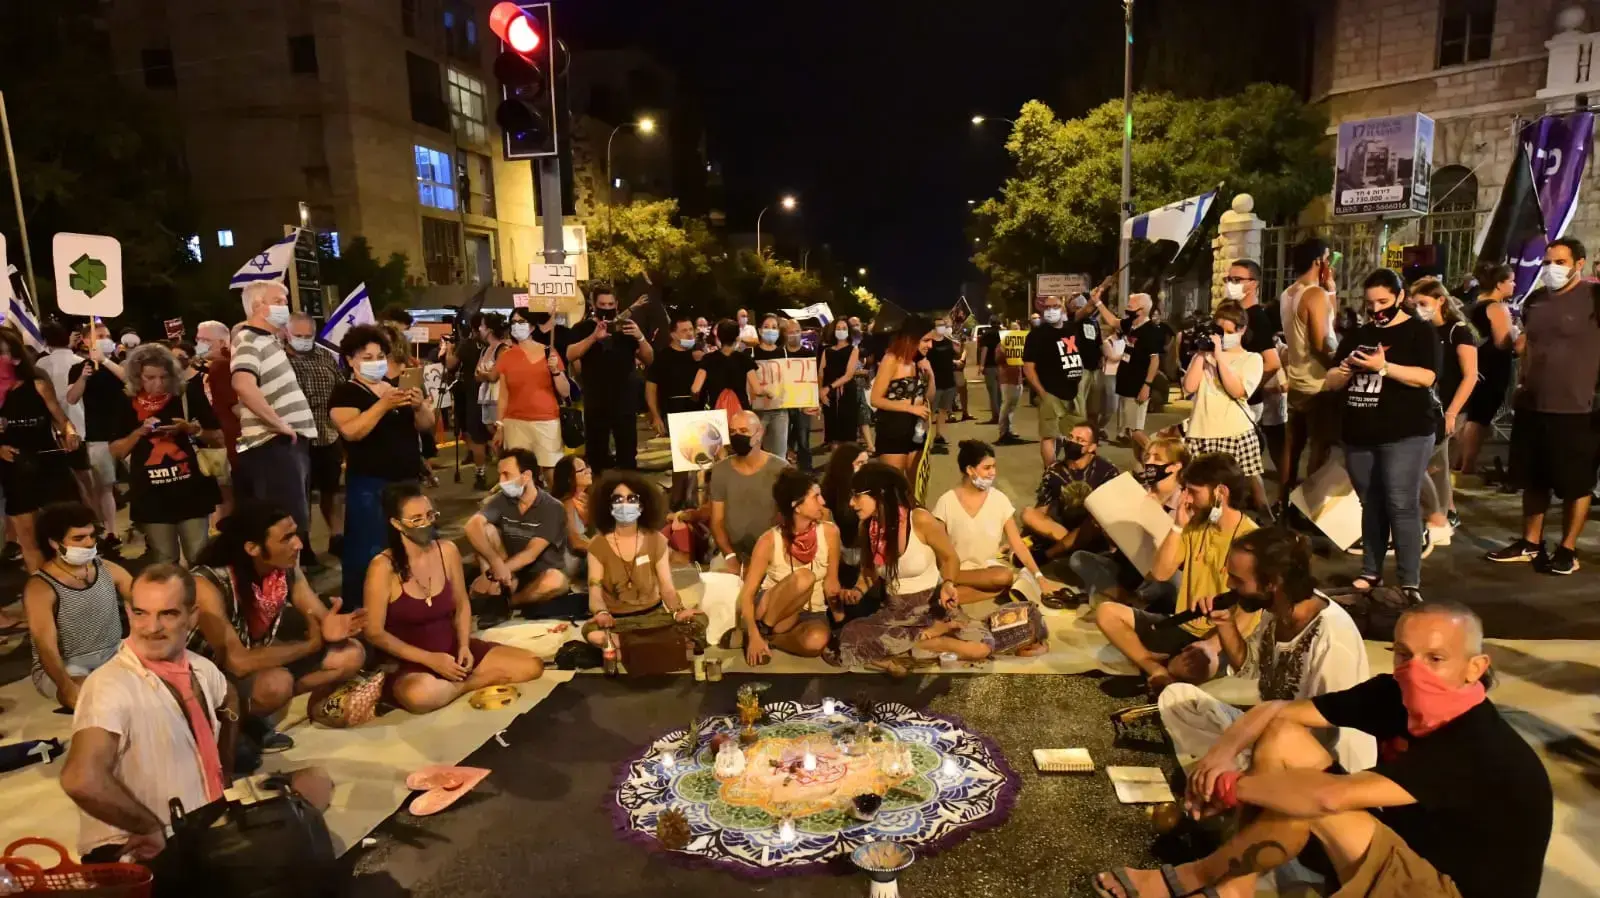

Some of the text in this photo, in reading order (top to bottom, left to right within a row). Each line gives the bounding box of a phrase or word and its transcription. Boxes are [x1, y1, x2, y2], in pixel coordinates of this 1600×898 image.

[544, 265, 575, 276] ביבי
[529, 282, 574, 295] תתפטר
[147, 467, 169, 478] מצב
